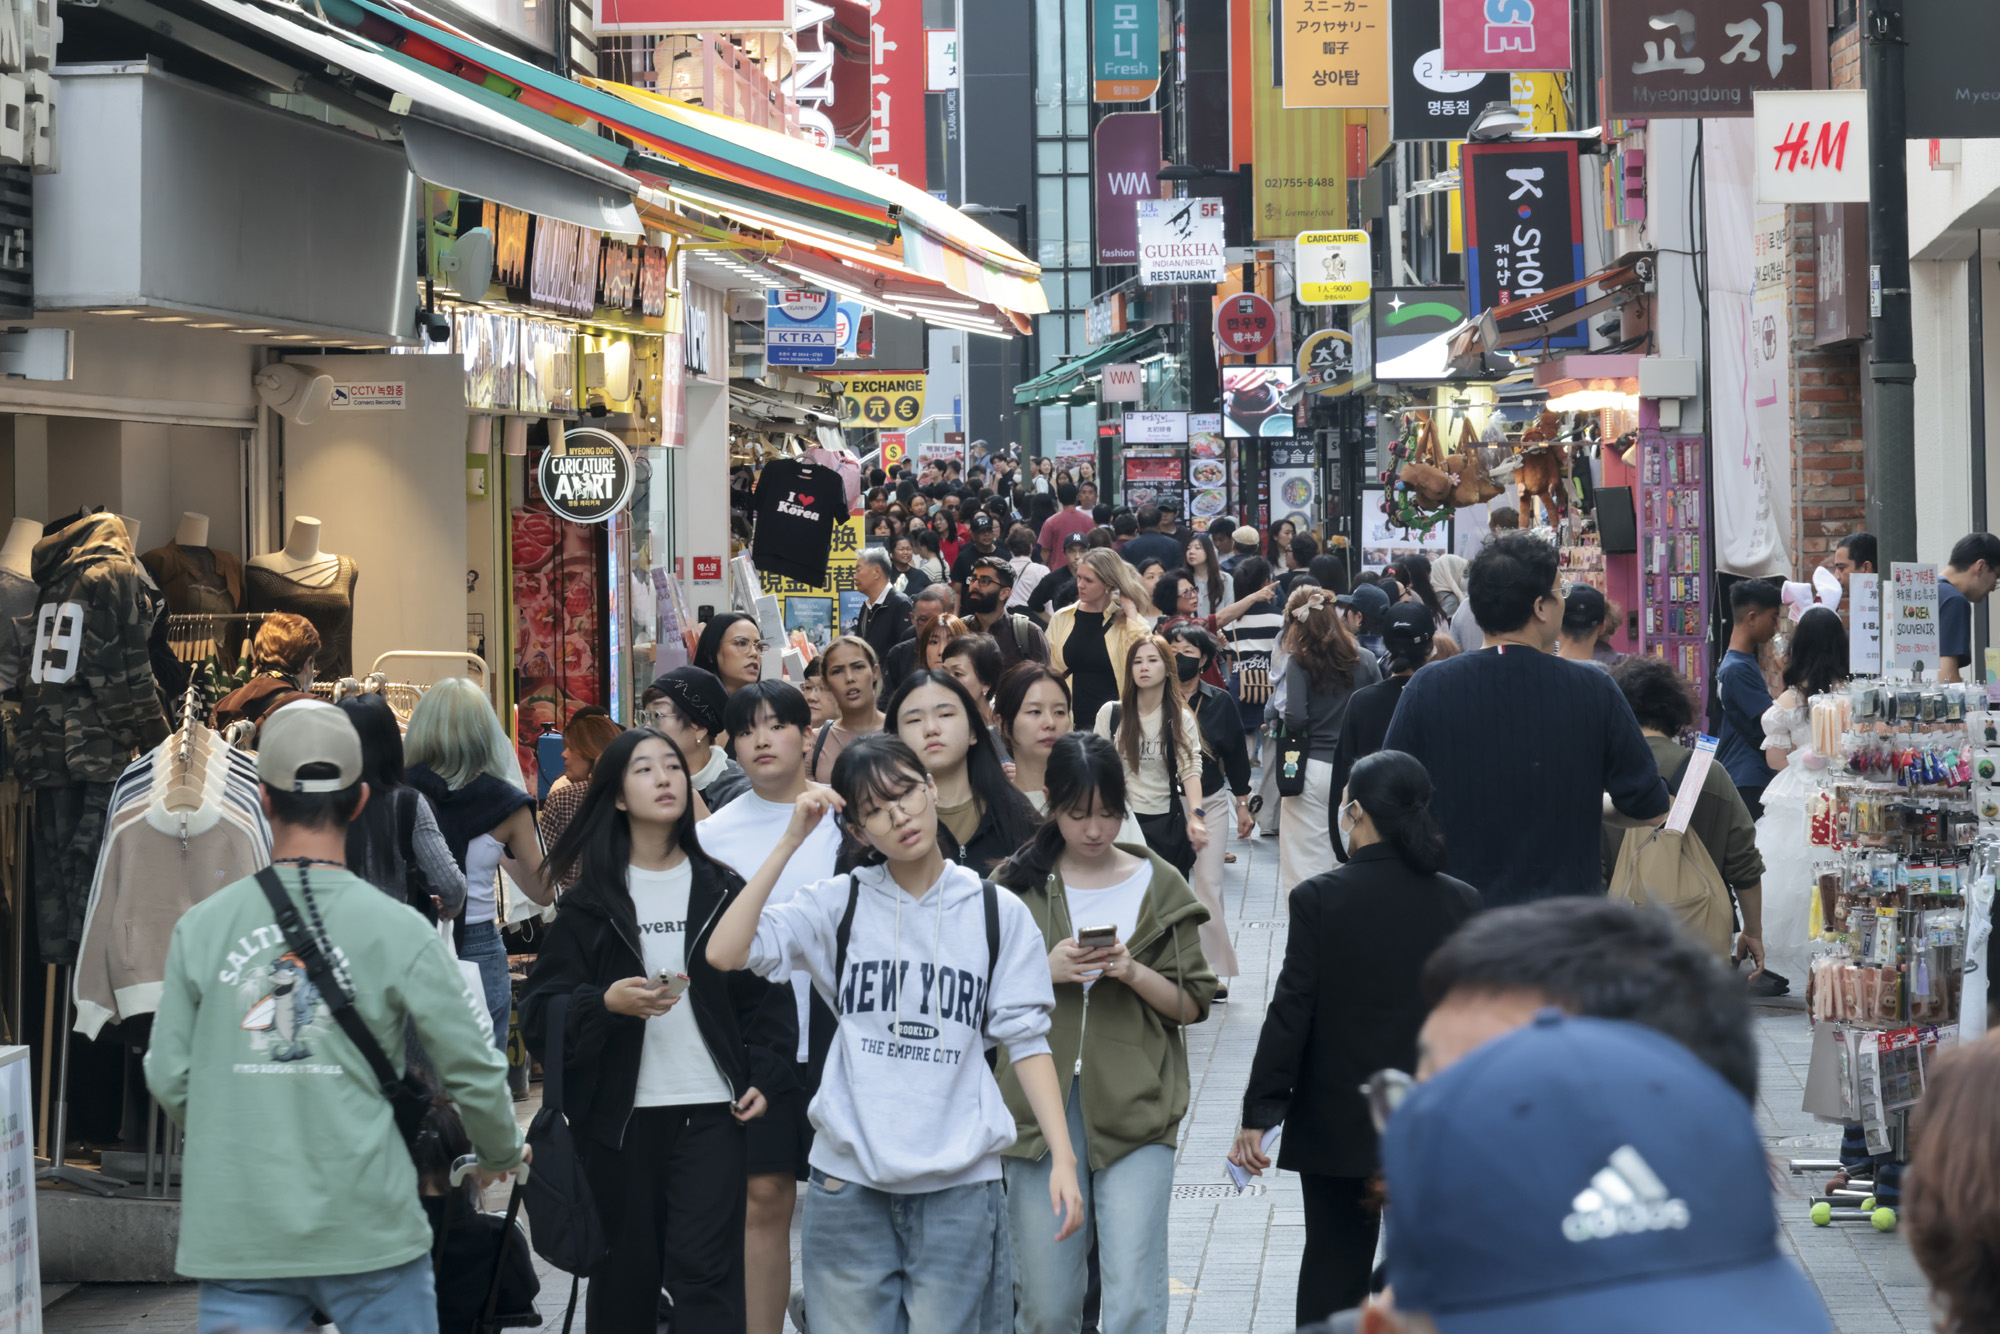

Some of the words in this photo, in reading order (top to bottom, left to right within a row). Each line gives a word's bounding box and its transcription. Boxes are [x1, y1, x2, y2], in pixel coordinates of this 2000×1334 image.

[1631, 1, 1797, 80] 교자
[1322, 41, 1350, 55] 帽子
[1105, 62, 1148, 75] Fresh
[1312, 69, 1360, 86] 상아탑
[1632, 86, 1741, 105] Myeongdong
[1427, 100, 1470, 116] 명동점
[1773, 120, 1850, 173] H&M
[1107, 172, 1152, 196] WM
[1264, 177, 1335, 189] 02)755-8488
[1201, 203, 1219, 217] 5F
[1306, 233, 1360, 243] CARICATURE
[1101, 248, 1136, 258] fashion
[1144, 243, 1220, 258] GURKHA
[1152, 259, 1214, 268] INDIAN/NEPALI
[1150, 269, 1217, 282] RESTAURANT
[778, 332, 825, 344] KTRA
[1109, 370, 1136, 385] WM
[350, 386, 377, 396] CCTV
[377, 385, 404, 396] 녹화중
[852, 380, 923, 393] EXCHANGE
[569, 447, 595, 456] MYEONG
[595, 446, 614, 455] DONG
[551, 457, 616, 475] CARICATURE
[787, 491, 796, 503] I
[776, 500, 820, 521] Korea
[696, 563, 718, 572] 에스원
[1895, 568, 1913, 587] 한국
[1902, 605, 1931, 620] KOREA
[1896, 623, 1936, 636] SOUVENIR
[840, 959, 910, 1016] NEW
[919, 962, 989, 1031] YORK
[861, 1037, 884, 1054] THE
[888, 1043, 931, 1063] EMPIRE
[933, 1047, 962, 1065] CITY
